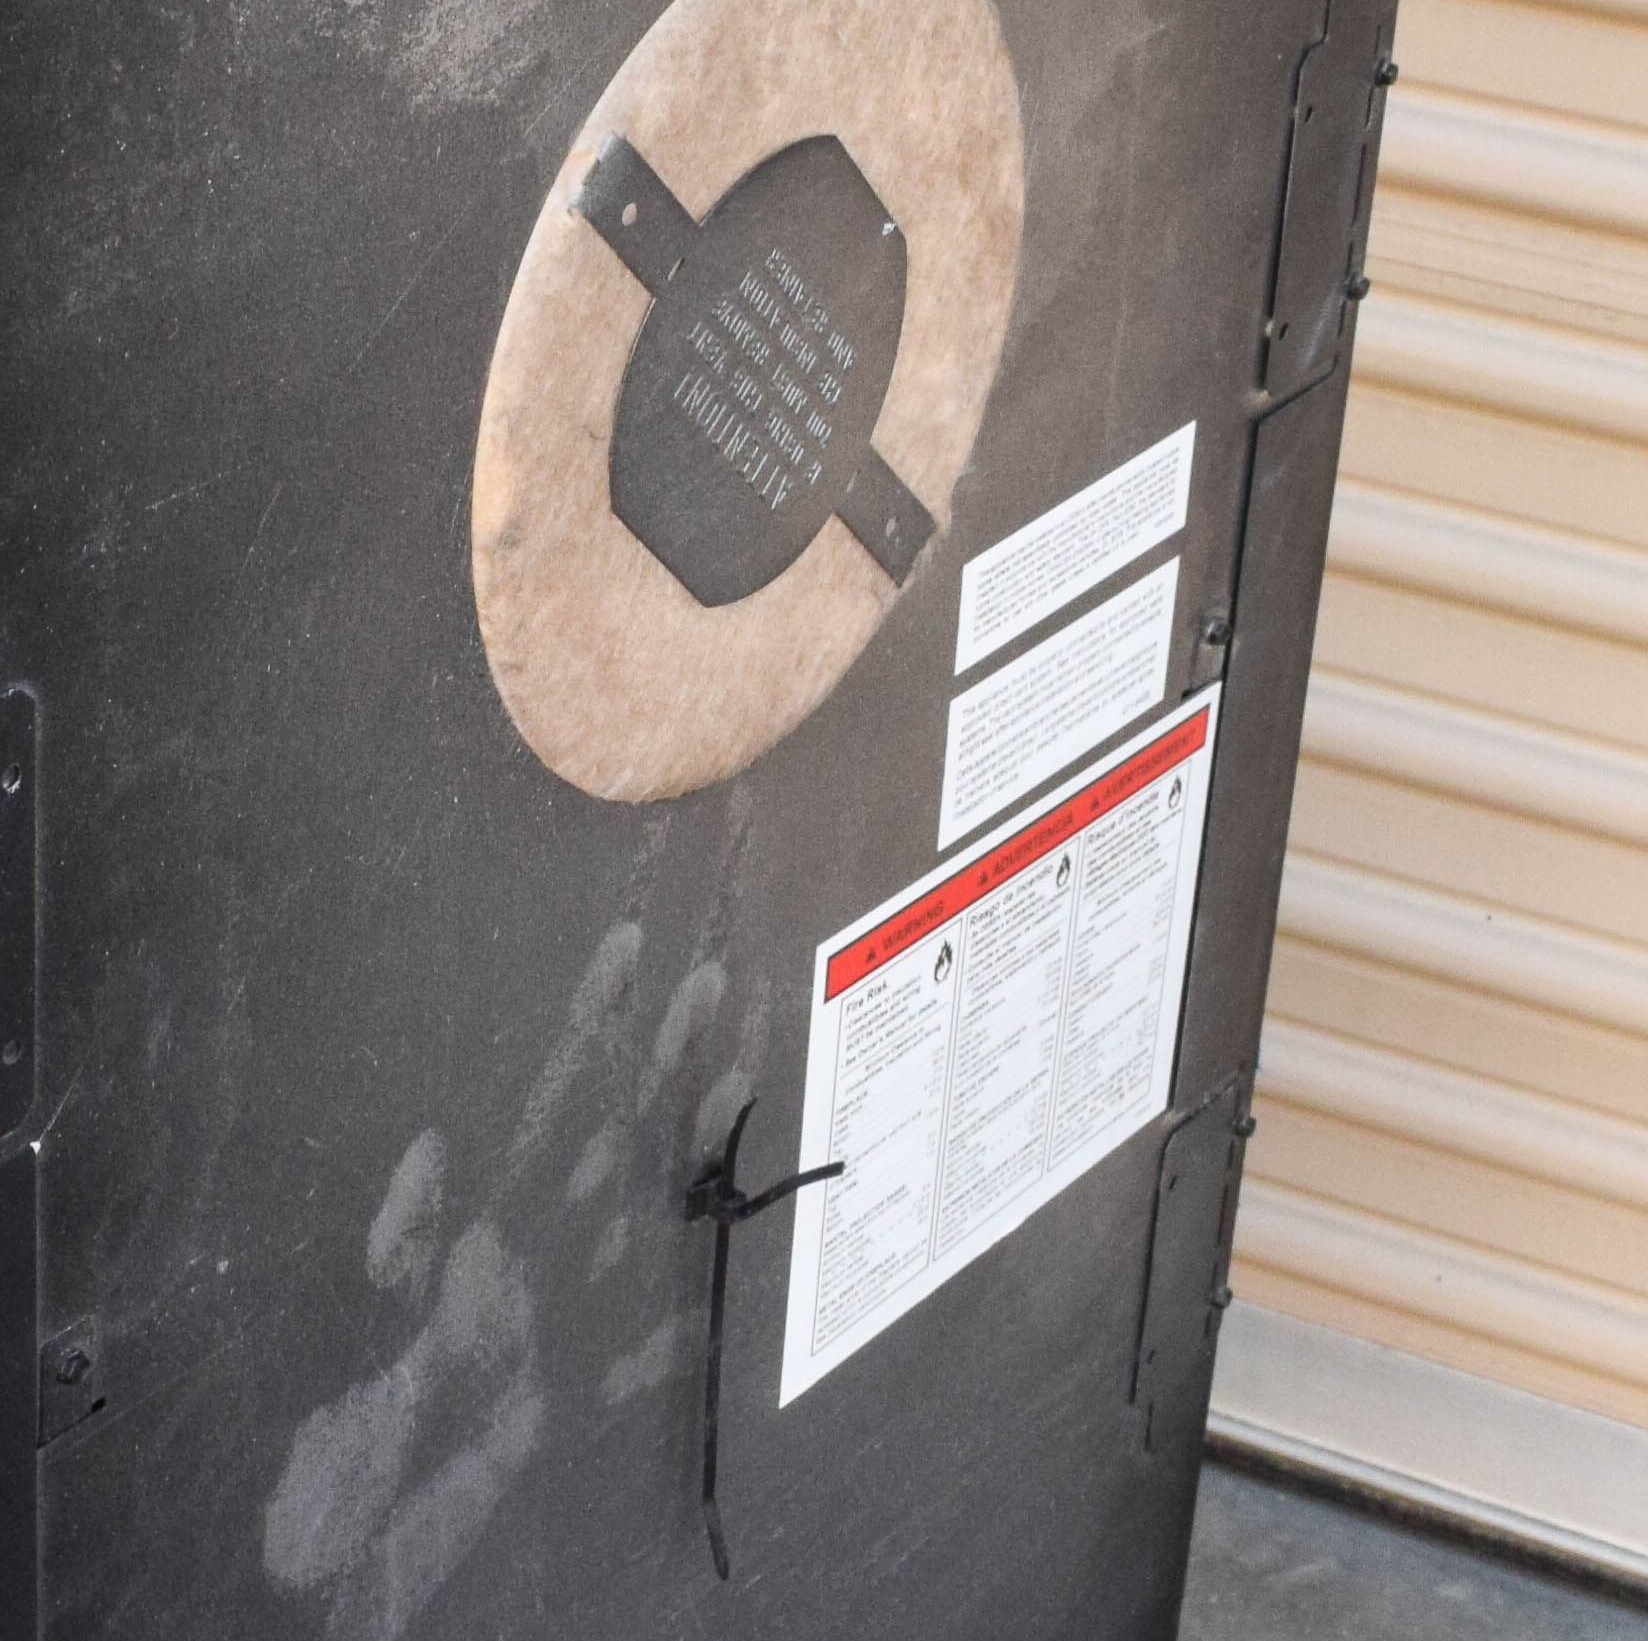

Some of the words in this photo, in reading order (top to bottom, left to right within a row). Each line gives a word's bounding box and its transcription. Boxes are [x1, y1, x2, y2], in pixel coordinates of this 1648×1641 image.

[993, 811, 1073, 876] ADVERTENCIA
[1087, 818, 1115, 846] Risque
[969, 898, 1000, 930] Riesgo
[1002, 890, 1013, 905] de
[1016, 862, 1053, 895] Incendio
[883, 899, 943, 952] WARNING
[845, 993, 864, 1015] Fire
